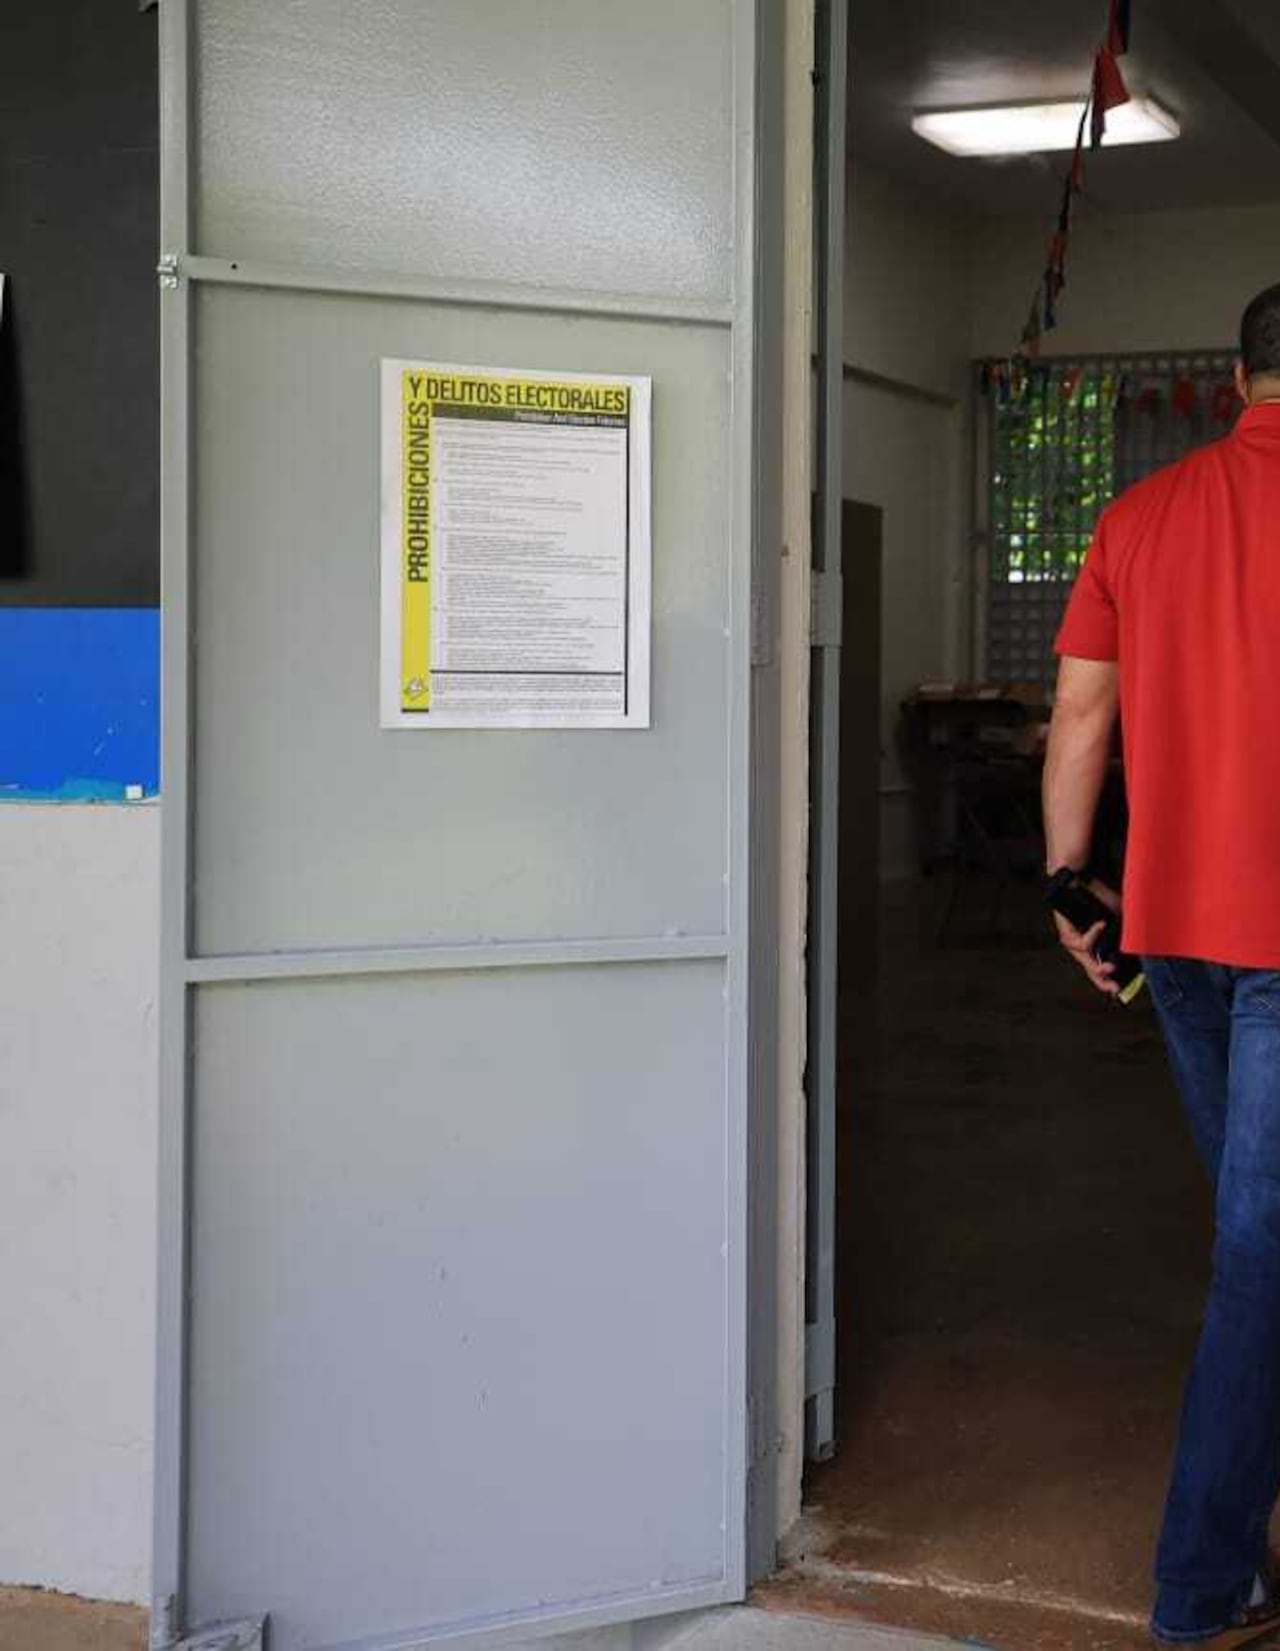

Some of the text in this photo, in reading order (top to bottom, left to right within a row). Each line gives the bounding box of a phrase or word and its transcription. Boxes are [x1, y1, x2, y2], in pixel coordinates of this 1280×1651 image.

[408, 376, 626, 412] Y DELITOS ELECTORALES
[408, 401, 429, 583] PROHIBICIONES
